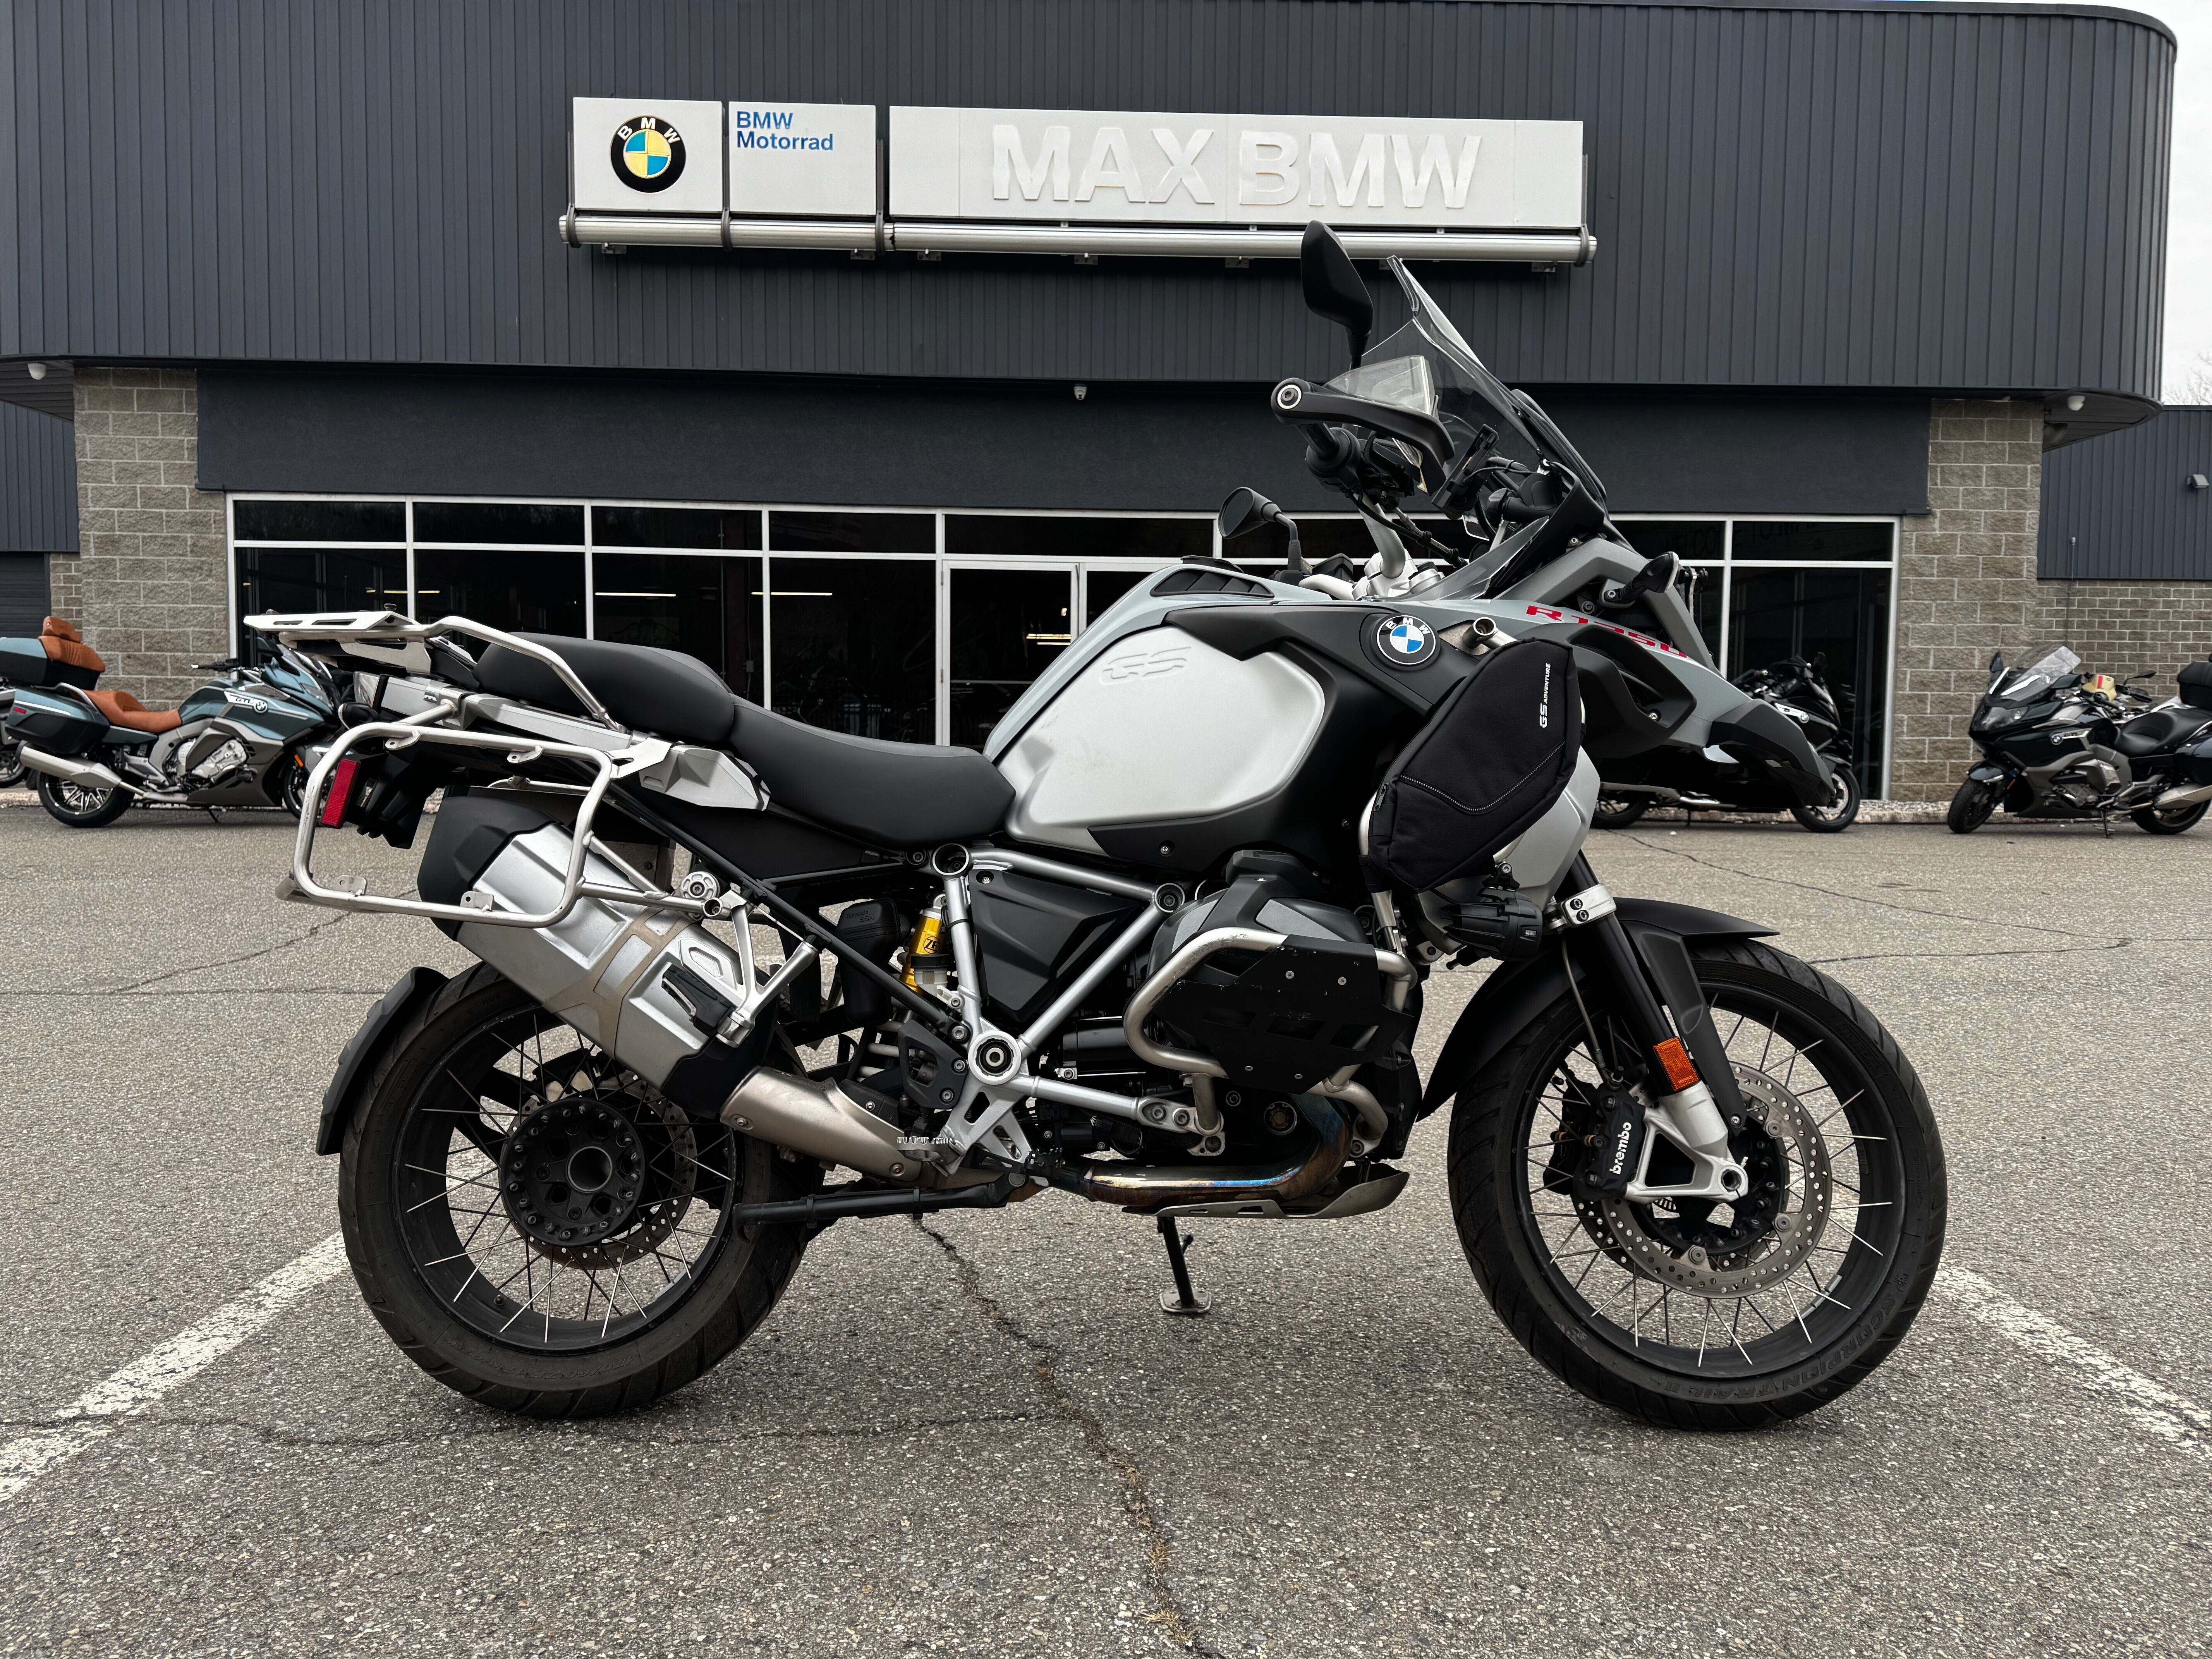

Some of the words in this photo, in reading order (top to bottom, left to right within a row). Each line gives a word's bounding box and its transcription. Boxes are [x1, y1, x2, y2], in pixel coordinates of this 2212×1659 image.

[617, 117, 680, 144] BMW
[737, 111, 793, 130] BMW
[737, 131, 833, 151] Motorrad
[993, 124, 1215, 204] MAX
[1239, 129, 1482, 209] BMW
[1385, 617, 1431, 634] BMW
[1099, 646, 1192, 685] GS
[1539, 703, 1548, 728] GS
[859, 914, 875, 923] ESA
[924, 937, 940, 952] ZF
[1609, 1122, 1632, 1175] brembo
[1783, 1293, 1896, 1391] SCORPION
[1690, 1384, 1774, 1399] TRAIL
